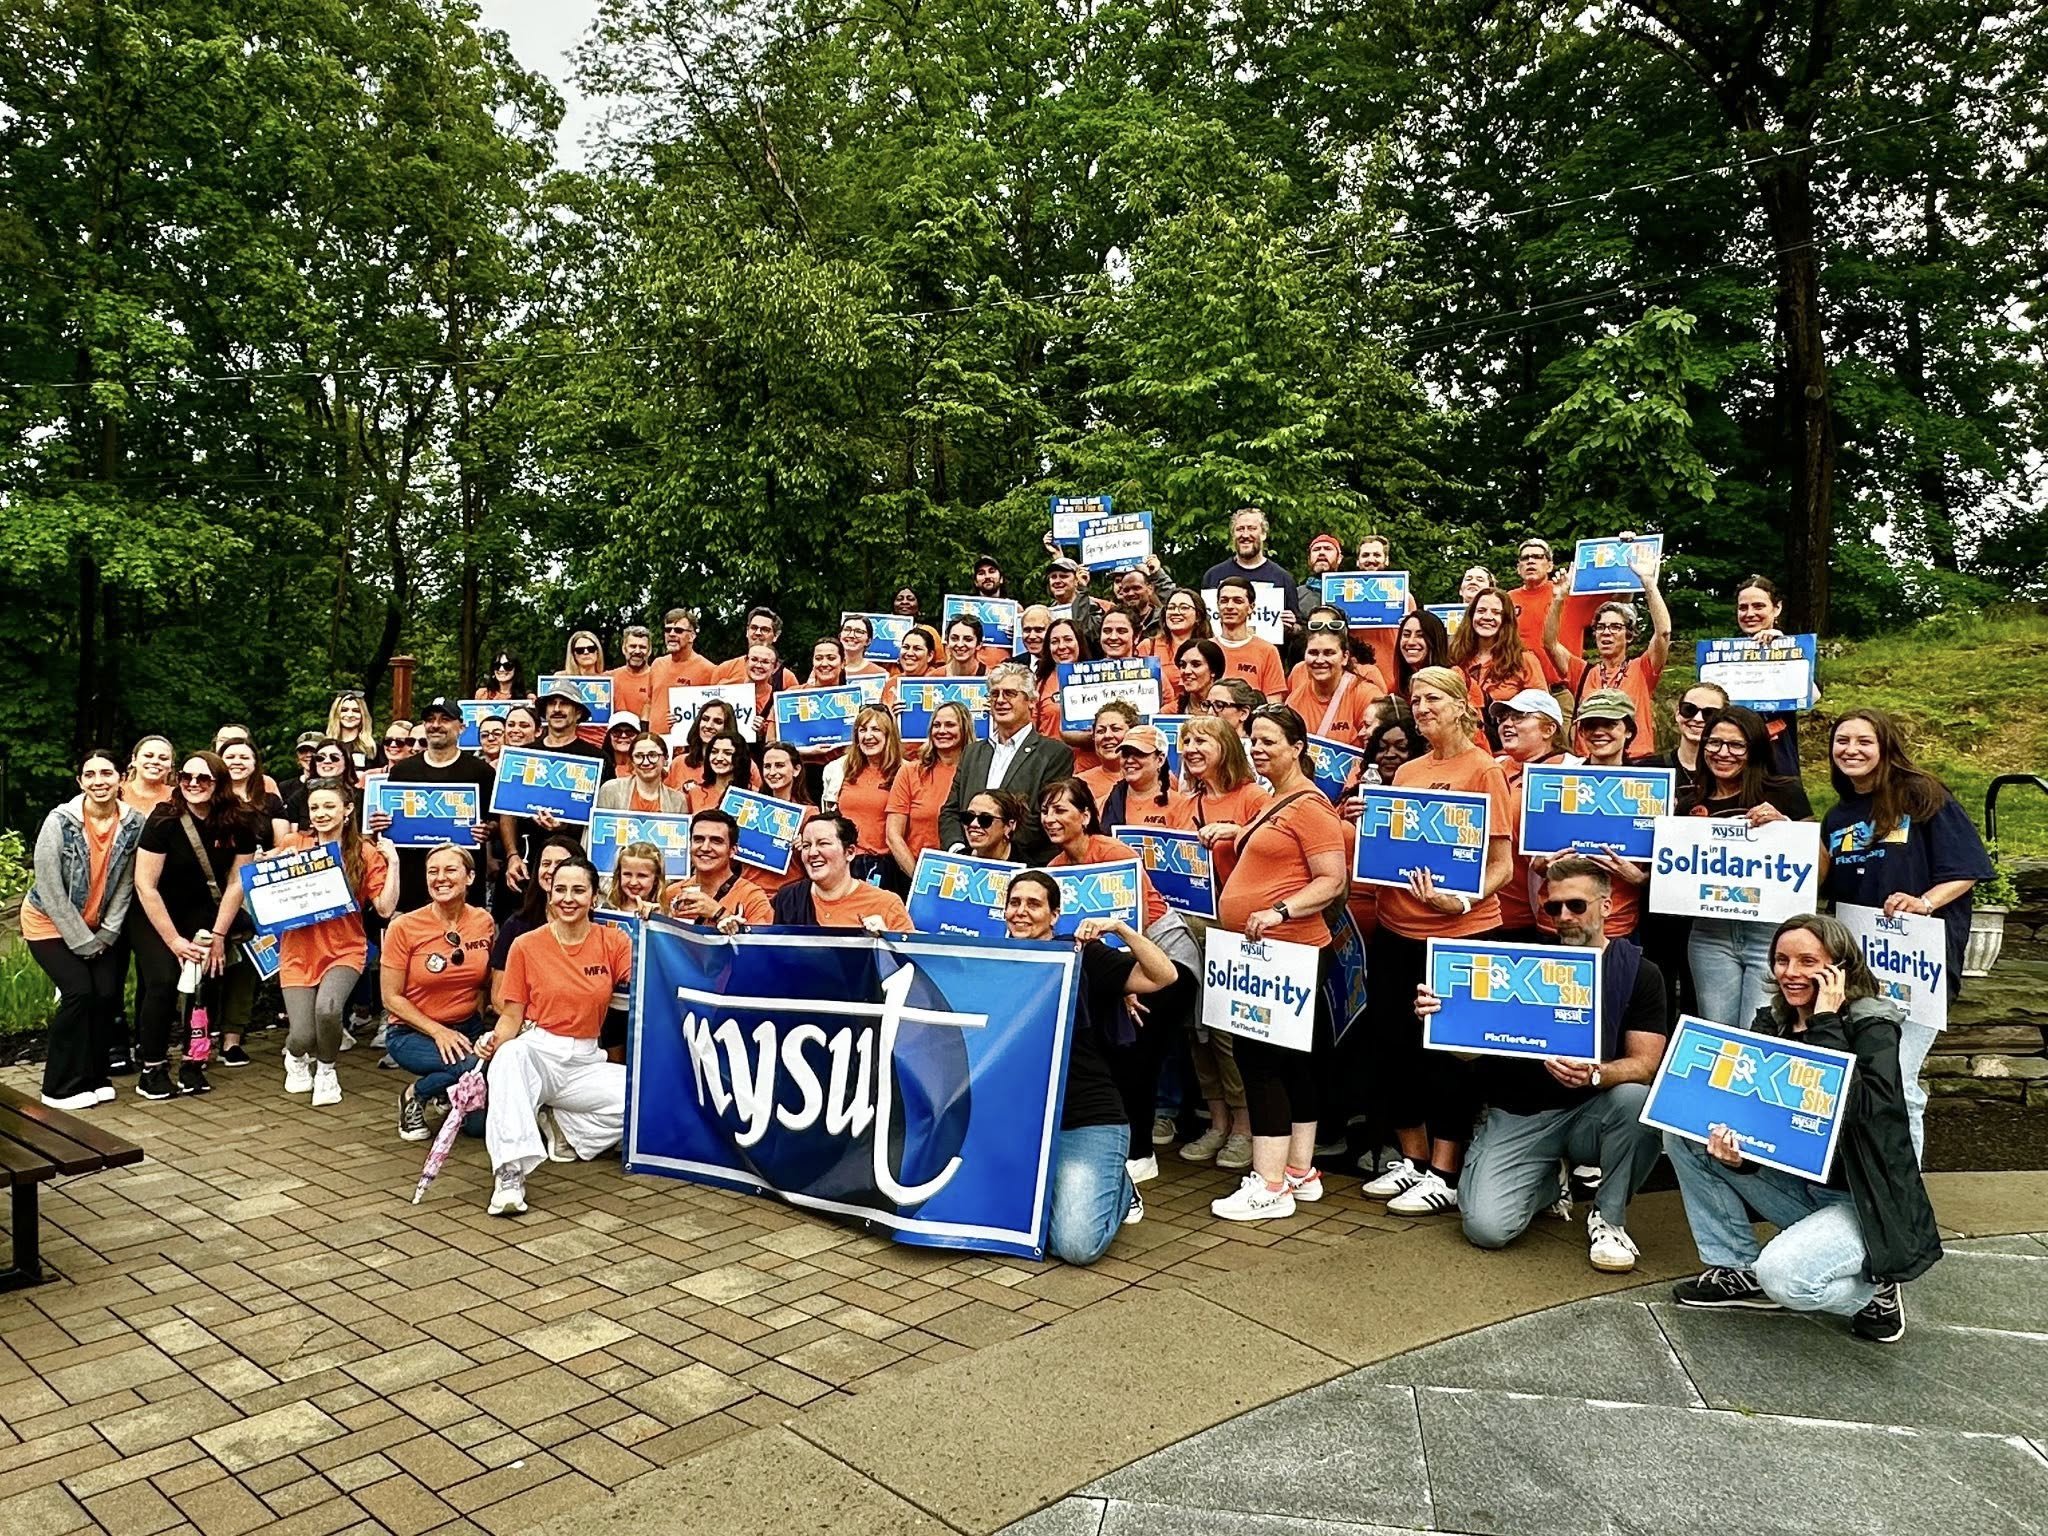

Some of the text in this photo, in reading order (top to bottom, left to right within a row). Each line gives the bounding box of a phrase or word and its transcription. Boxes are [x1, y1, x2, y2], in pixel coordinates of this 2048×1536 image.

[1577, 543, 1631, 570] FiX
[1326, 578, 1381, 602] FiX
[1091, 659, 1121, 671] won't
[1743, 650, 1762, 661] Fix
[1765, 650, 1788, 660] Tier
[1101, 671, 1117, 681] Fix
[1119, 669, 1139, 680] Tier
[1237, 663, 1258, 675] MFA
[780, 691, 836, 723] FiX
[1331, 721, 1351, 731] MFA
[500, 754, 569, 789] FiX
[1528, 773, 1623, 816] FiX
[1622, 779, 1653, 799] tier
[381, 790, 448, 818] FiX
[1637, 799, 1666, 816] six
[1144, 814, 1167, 825] MFA
[1361, 796, 1443, 844] FiX
[1442, 806, 1471, 826] tier
[1457, 827, 1482, 847] six
[1711, 822, 1759, 842] nysut
[289, 861, 307, 878] Fix
[1657, 844, 1813, 893] Solidarity
[916, 859, 985, 906] FiX
[1699, 884, 1742, 903] FiX
[1700, 904, 1760, 918] FixTier6.org
[465, 940, 487, 951] MFA
[1241, 941, 1273, 962] nysut
[584, 965, 609, 976] MFA
[1540, 961, 1578, 986] tier
[1862, 935, 1942, 994] lidarity
[1207, 959, 1312, 1017] Solidarity
[1433, 951, 1544, 1005] FiX
[1560, 984, 1592, 1007] six
[1554, 1008, 1591, 1025] nysut
[1484, 1032, 1548, 1049] FixTier6.org
[1666, 1028, 1791, 1109] FiX
[1788, 1059, 1826, 1089] tier
[677, 962, 989, 1206] nysut
[1799, 1086, 1836, 1116] six
[1717, 1272, 1747, 1297] N
